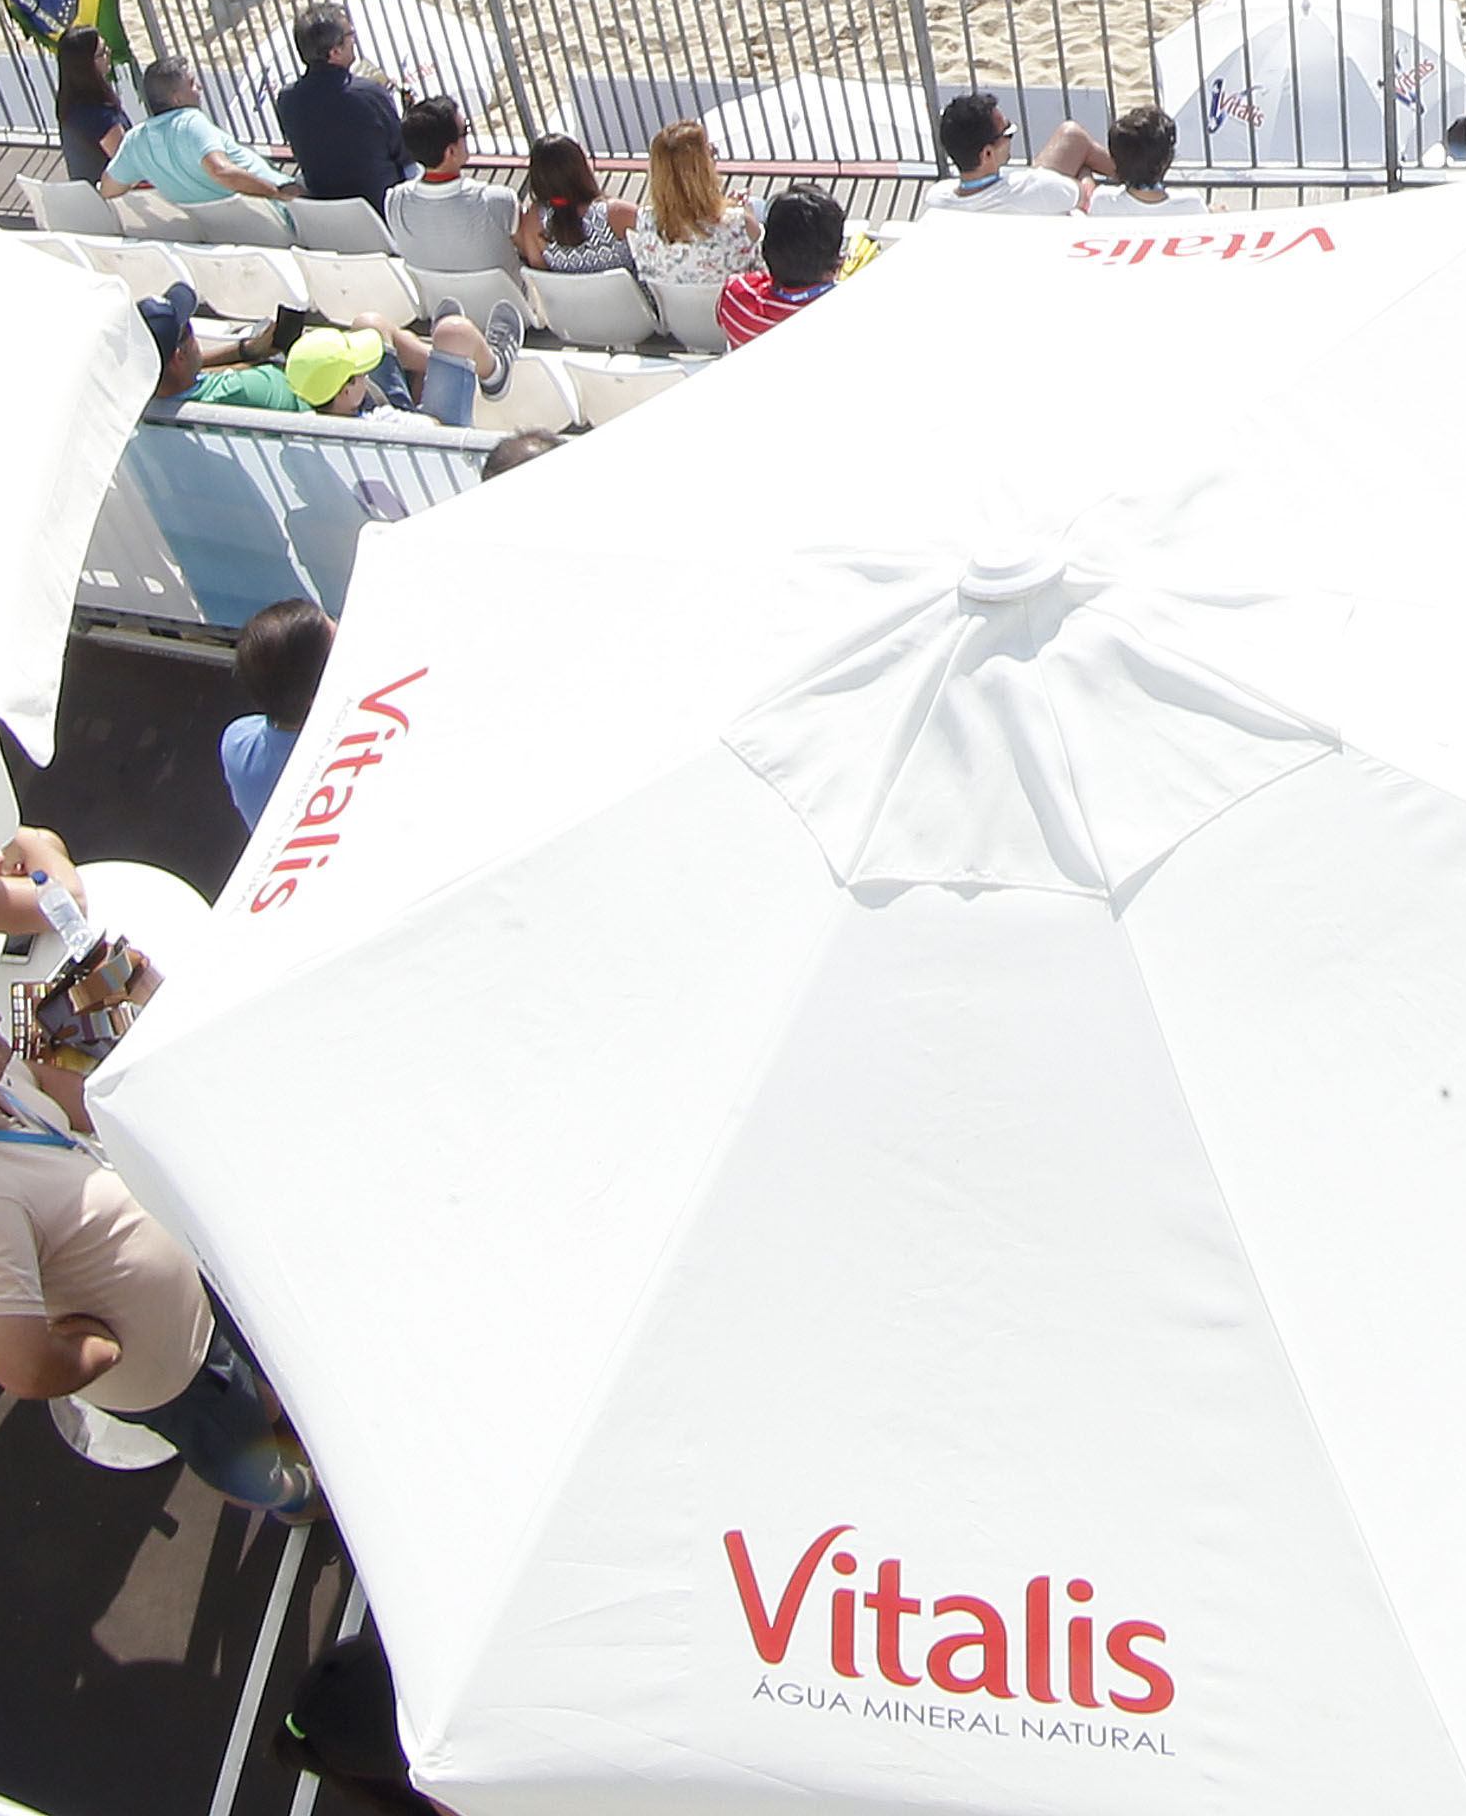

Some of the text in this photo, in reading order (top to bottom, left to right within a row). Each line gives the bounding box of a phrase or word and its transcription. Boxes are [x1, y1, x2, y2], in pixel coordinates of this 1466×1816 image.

[1066, 226, 1336, 266] Vitalis
[249, 666, 429, 914] Vitalis
[723, 1523, 1176, 1715] Vitalis
[751, 1674, 1176, 1757] ÁGUA MINERAL NATURAL
